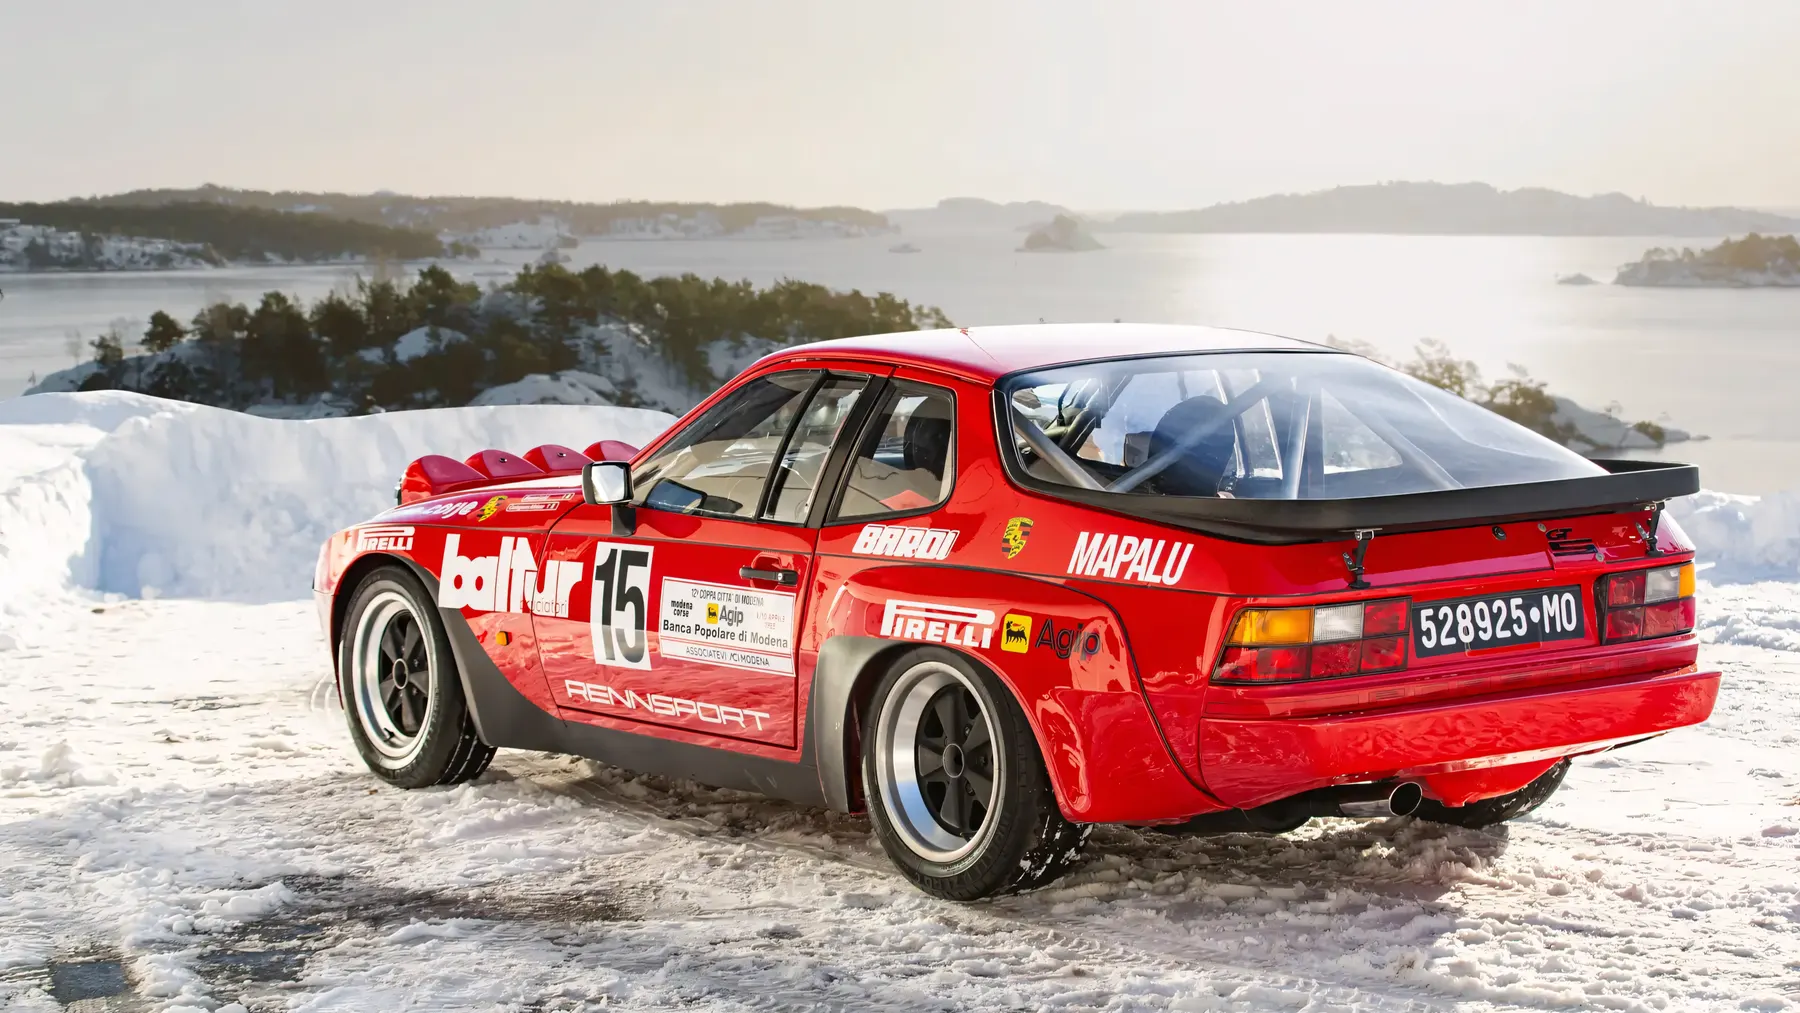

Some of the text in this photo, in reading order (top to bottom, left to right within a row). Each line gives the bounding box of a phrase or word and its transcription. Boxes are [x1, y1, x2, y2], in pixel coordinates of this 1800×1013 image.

[356, 526, 416, 551] PIRELLI
[852, 523, 960, 561] BARDI
[1066, 531, 1195, 586] MAPALU
[595, 548, 650, 663] 15
[670, 600, 693, 610] modena
[673, 608, 690, 618] corse
[741, 595, 765, 607] MODENA
[719, 605, 744, 627] Agip
[880, 599, 996, 649] PIRELLI
[663, 619, 789, 648] Banca Popolare di Modena
[1035, 618, 1101, 661] Agip
[686, 646, 727, 661] ASSOCIATEVI
[740, 655, 770, 667] MODENA
[564, 679, 770, 731] RENNSPORT
